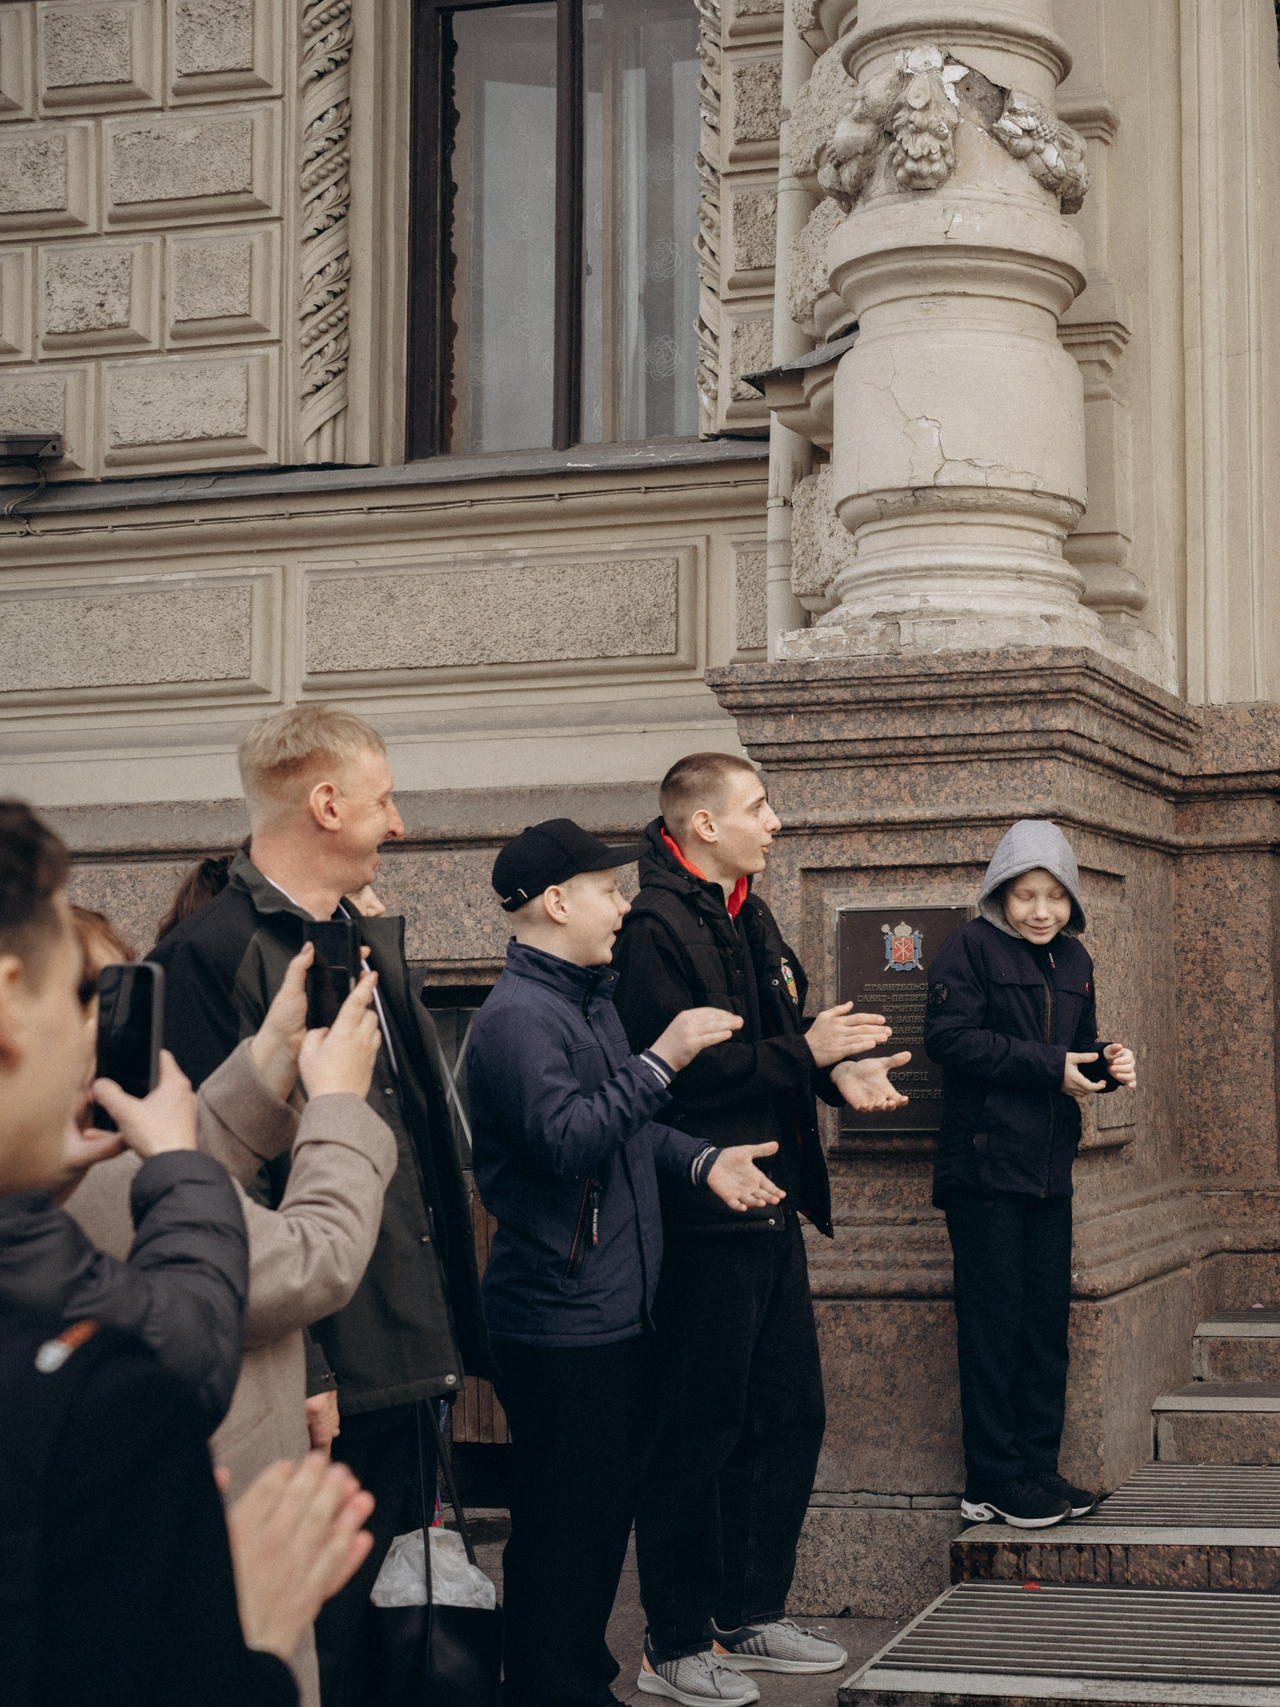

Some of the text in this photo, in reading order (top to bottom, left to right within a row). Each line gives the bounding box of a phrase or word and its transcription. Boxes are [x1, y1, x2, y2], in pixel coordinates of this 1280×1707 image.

[864, 983, 929, 992] ПРАВИТЕЛЬСТ
[857, 993, 927, 1003] САНКТ-ПЕТЕРБ
[882, 1004, 925, 1013] КОМИТЕТ
[896, 1015, 926, 1023] ЗАПИС
[887, 1071, 929, 1082] ВОРЕЦ
